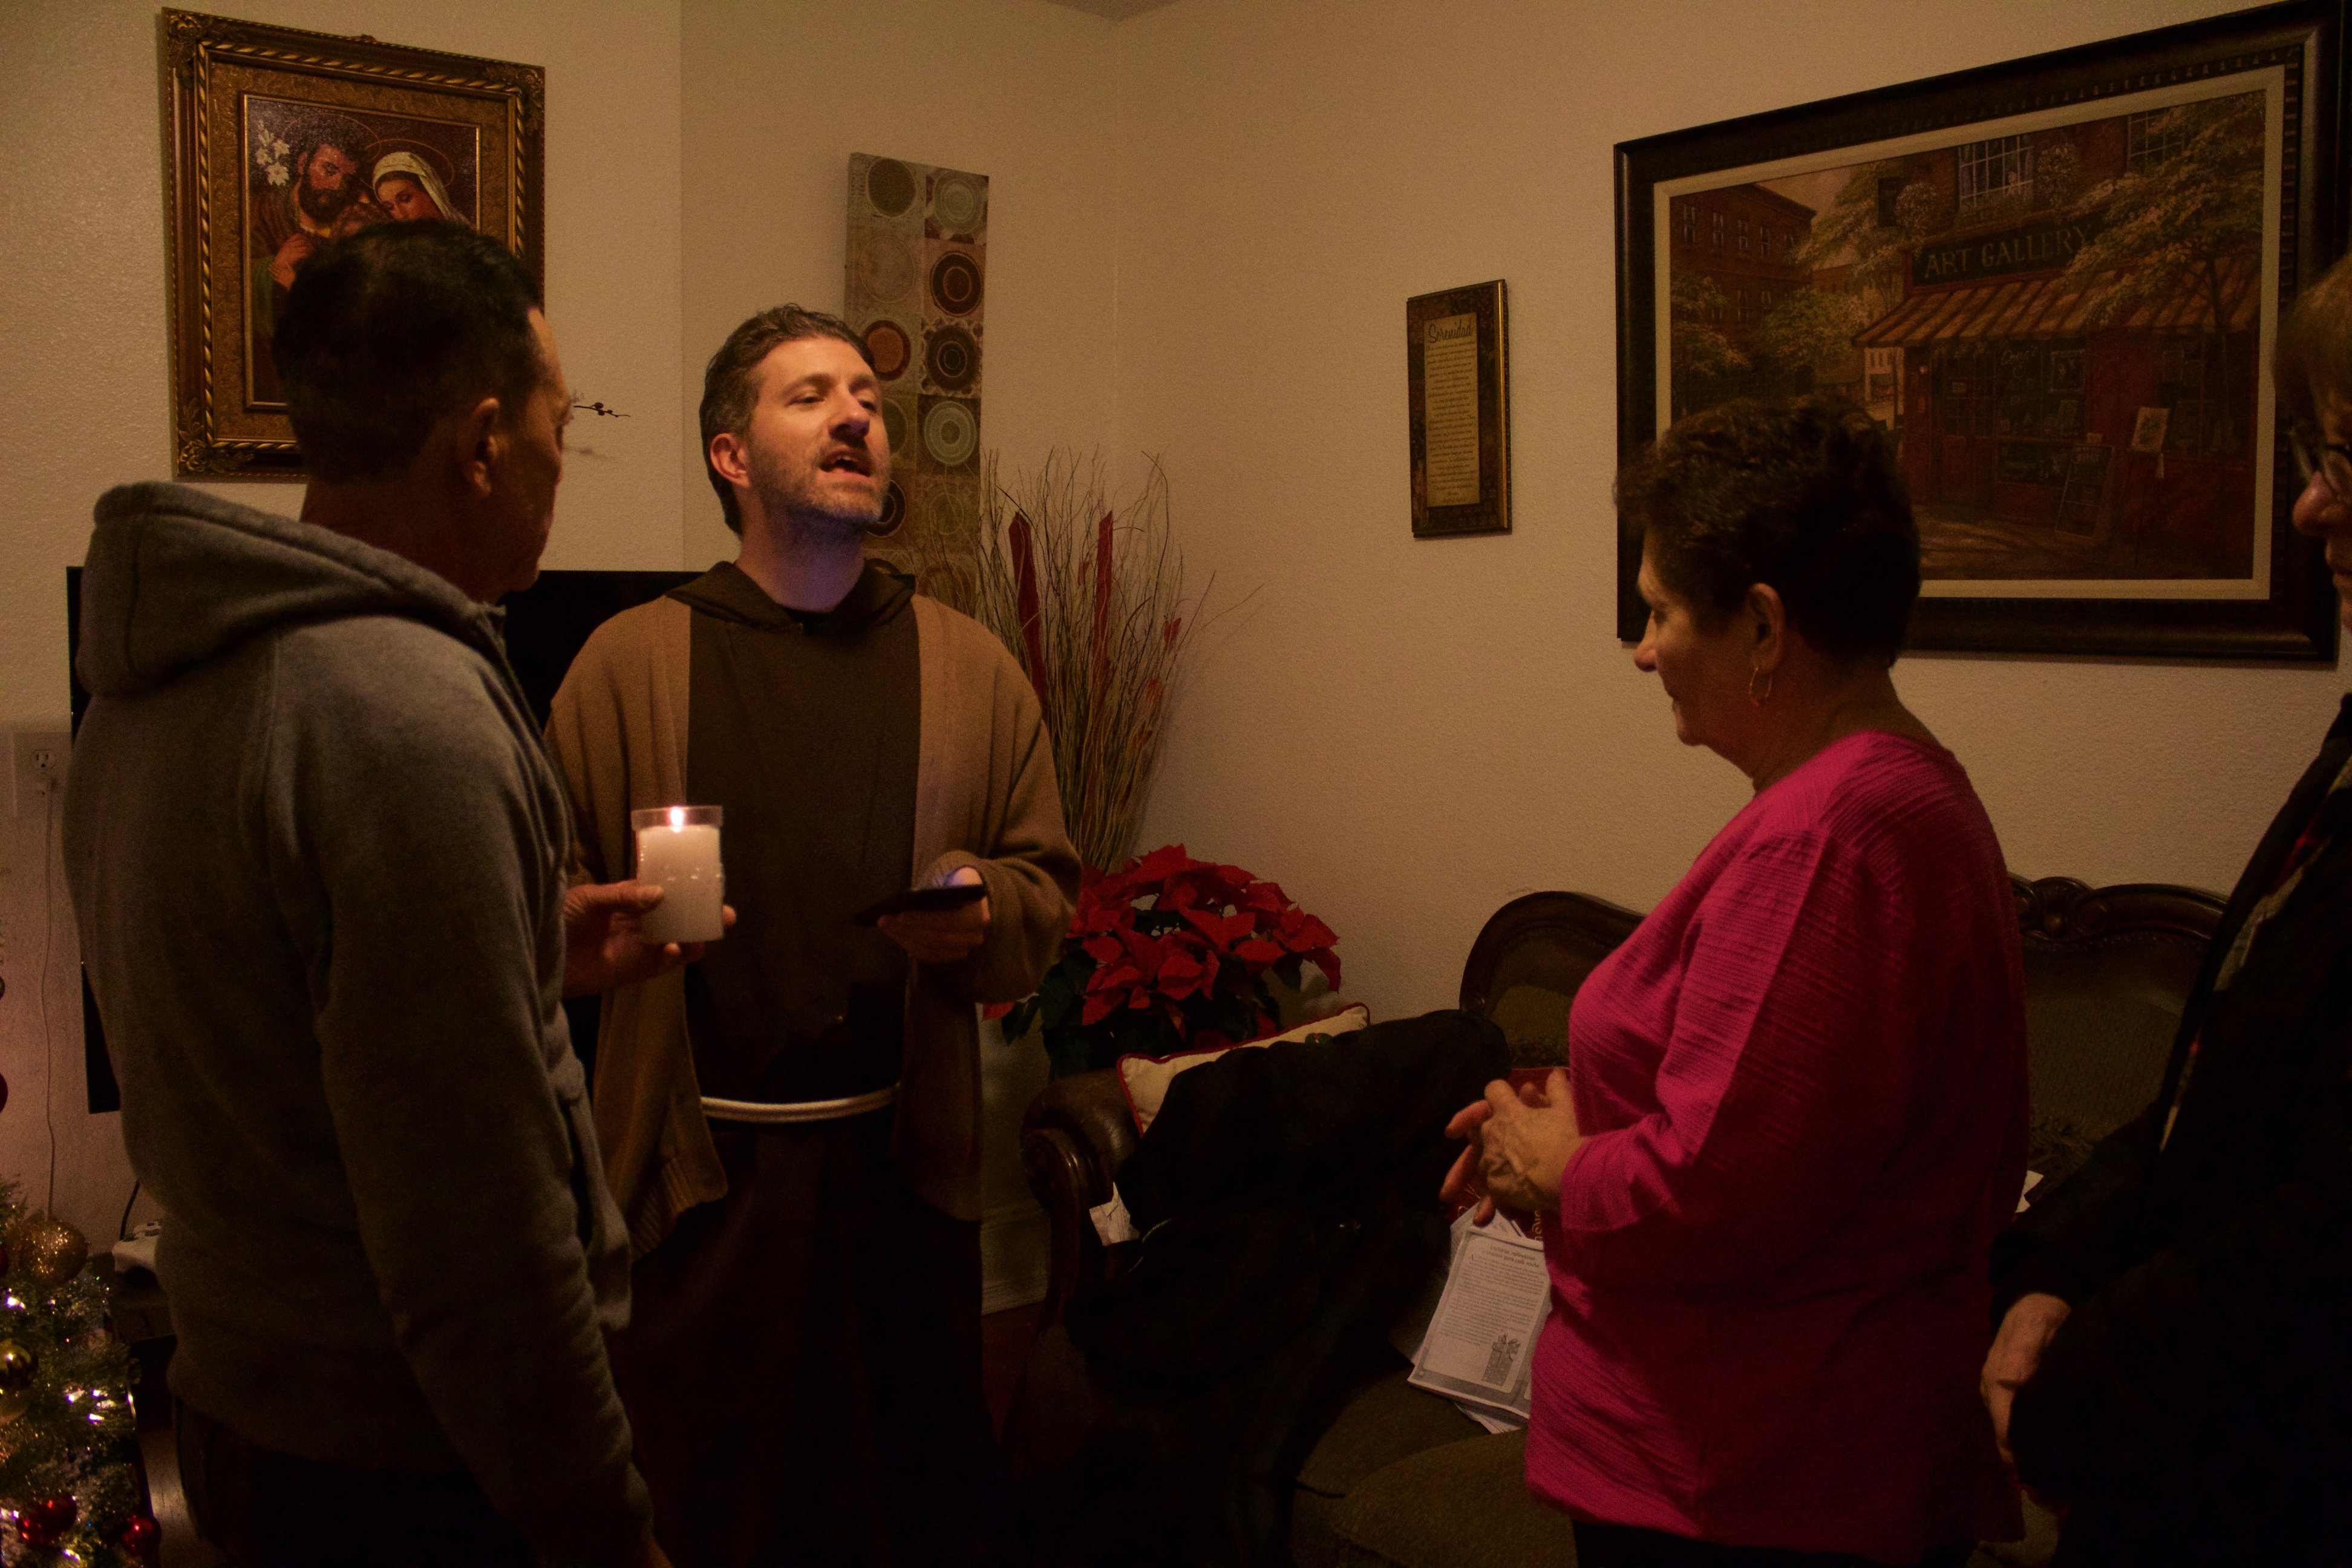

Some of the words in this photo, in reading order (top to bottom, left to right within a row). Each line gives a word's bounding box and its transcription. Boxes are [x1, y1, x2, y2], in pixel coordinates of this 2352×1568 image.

[1924, 247, 1973, 279] ART
[1981, 224, 2092, 267] GALLERY
[1428, 317, 1472, 344] Serenidad
